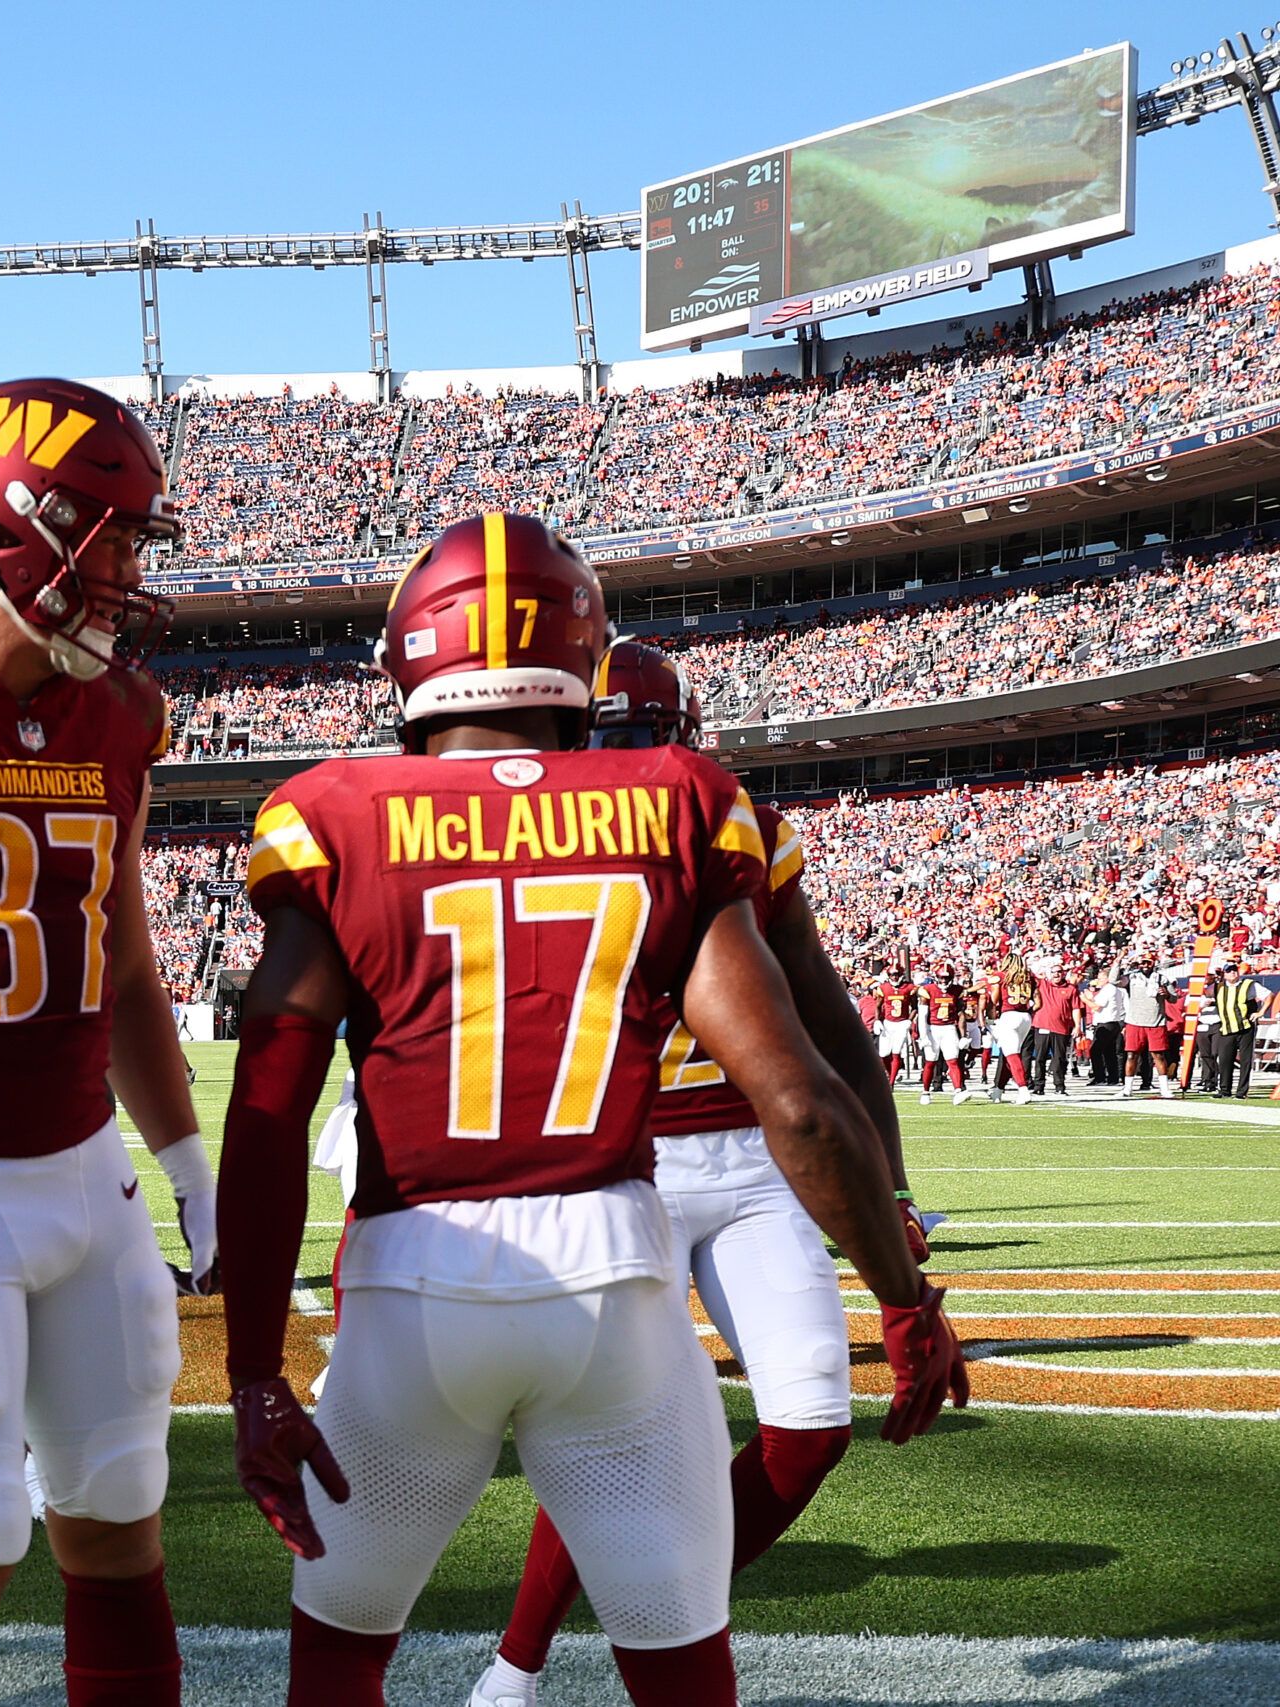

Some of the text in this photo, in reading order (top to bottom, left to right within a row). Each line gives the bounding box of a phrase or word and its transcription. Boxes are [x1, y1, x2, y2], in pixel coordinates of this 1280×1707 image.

[747, 161, 771, 187] 21
[673, 182, 701, 209] 20
[753, 198, 769, 214] 35
[687, 205, 735, 235] 11:47
[721, 234, 745, 248] BALL
[721, 248, 739, 259] ON:
[1201, 259, 1216, 270] 527
[812, 260, 972, 315] EMPOWER FIELD
[670, 287, 759, 323] EMPOWER
[1220, 428, 1234, 440] 80
[1237, 424, 1249, 436] R.
[1108, 450, 1155, 470] 30 DAVIS
[949, 477, 1041, 505] 65 ZIMMERMAN
[827, 509, 894, 528] 49 D. SMITH
[692, 538, 705, 549] 57
[718, 528, 771, 546] JACKSON
[589, 547, 640, 562] MORTON
[1100, 556, 1114, 565] 329
[246, 578, 310, 590] 18 TRIPUCKA
[355, 574, 367, 583] 12
[128, 584, 194, 596] NSOULIN
[684, 617, 698, 626] 327
[767, 726, 789, 735] BALL
[739, 736, 746, 744] &
[767, 734, 784, 743] ON:
[386, 788, 671, 863] McLAURIN
[423, 873, 652, 1140] 17
[890, 1000, 902, 1017] 3
